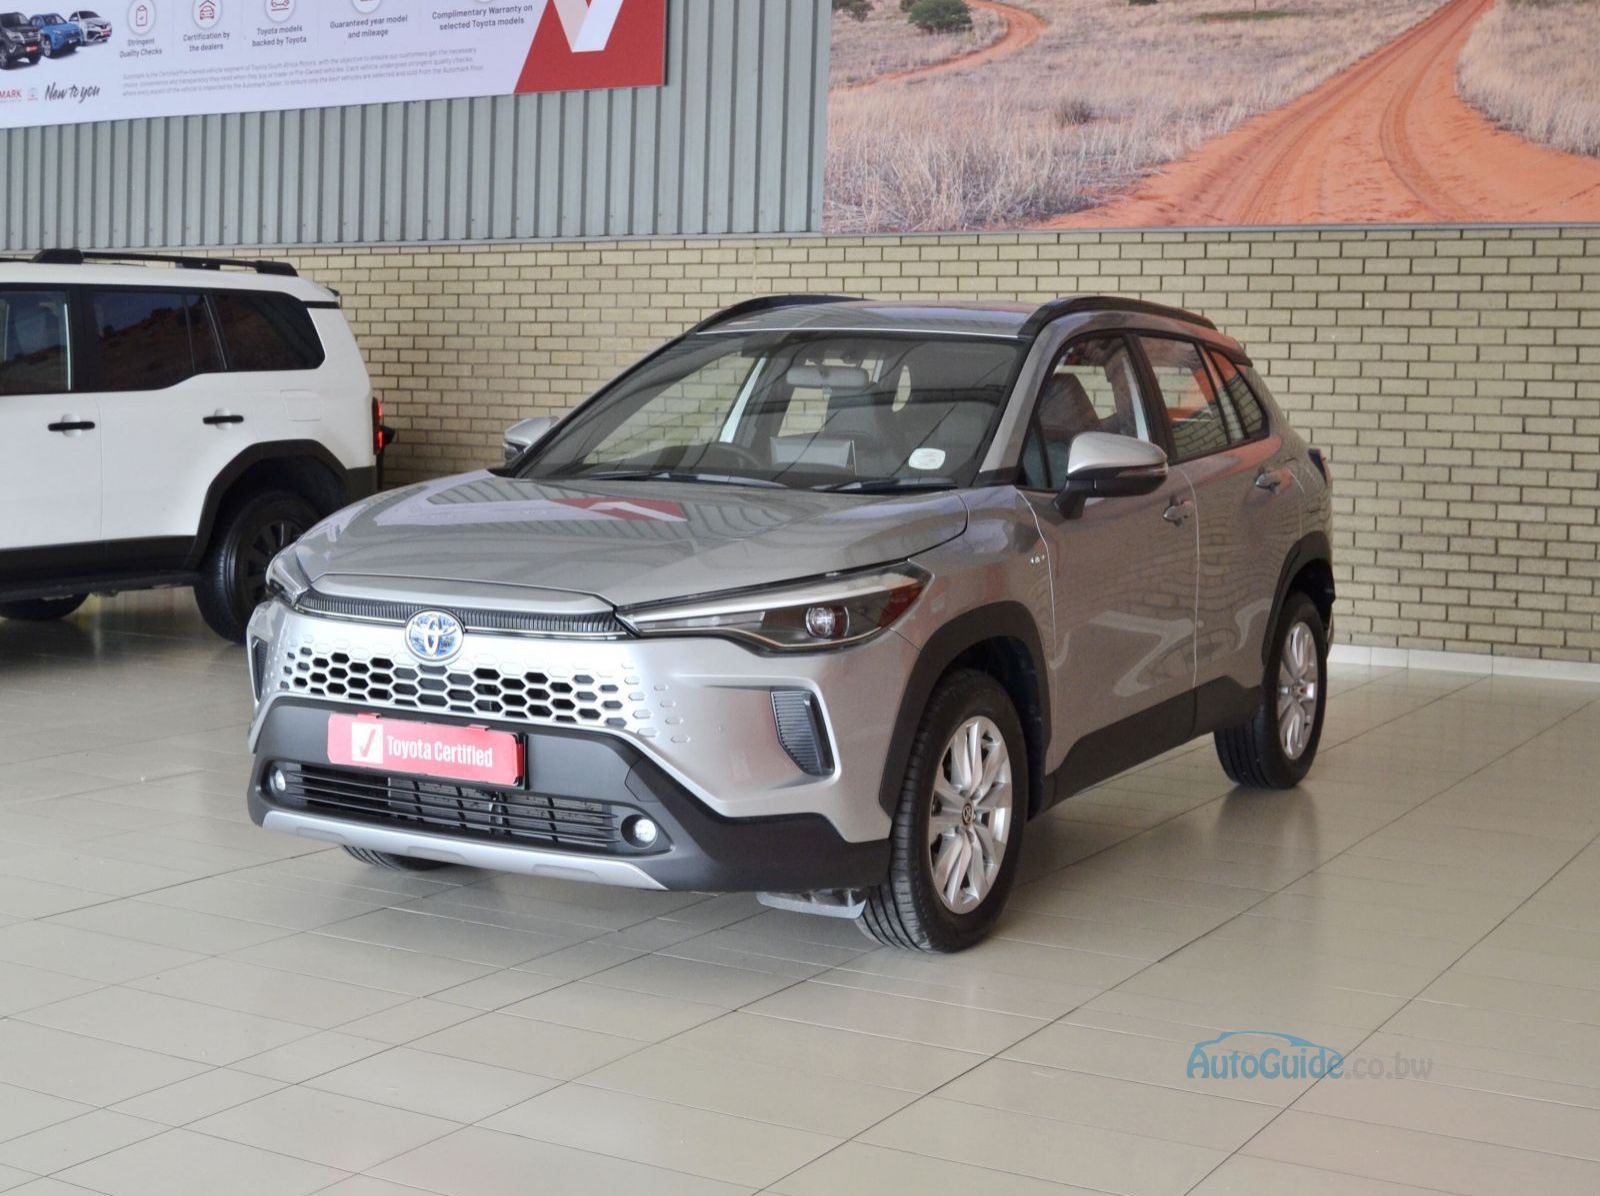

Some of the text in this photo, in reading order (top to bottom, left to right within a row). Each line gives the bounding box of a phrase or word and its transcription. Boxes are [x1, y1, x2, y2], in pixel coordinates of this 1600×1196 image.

[432, 4, 533, 20] Complimentary Warranty on
[330, 15, 408, 29] Guaranteed year model
[439, 16, 525, 31] selected Toyota models
[183, 31, 231, 42] Certification by
[257, 25, 303, 37] Toyota models
[347, 28, 389, 39] and mileage
[200, 43, 224, 51] dealers
[252, 35, 307, 47] backed by Toyota
[44, 81, 67, 102] New
[69, 84, 80, 99] to
[79, 85, 101, 104] you
[386, 735, 493, 768] Toyota Certified
